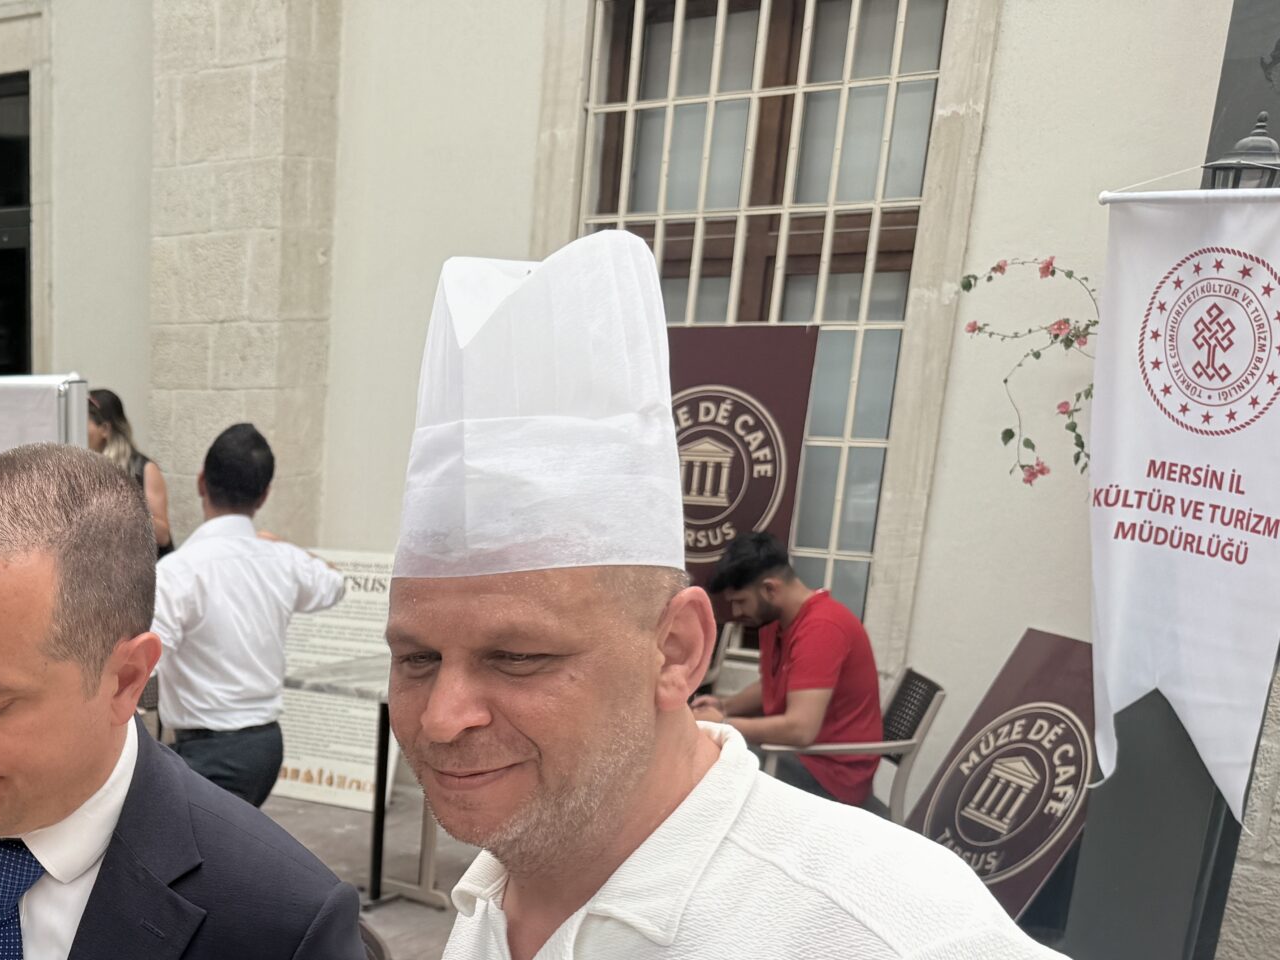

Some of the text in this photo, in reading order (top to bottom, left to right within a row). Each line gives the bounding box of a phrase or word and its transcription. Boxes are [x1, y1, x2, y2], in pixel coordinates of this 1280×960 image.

[1200, 281, 1240, 298] KÜLTÜR
[1241, 293, 1254, 308] VE
[1250, 306, 1268, 353] TURİZM
[734, 413, 773, 478] CAFE
[1146, 459, 1245, 495] MERSİN İL
[685, 521, 737, 548] RSUS
[1092, 484, 1280, 539] KÜLTÜR VE TURİZM
[1113, 520, 1249, 565] MÜDÜRLÜĞÜ
[959, 718, 1027, 776] MÜZE
[1043, 743, 1076, 818] CAFE
